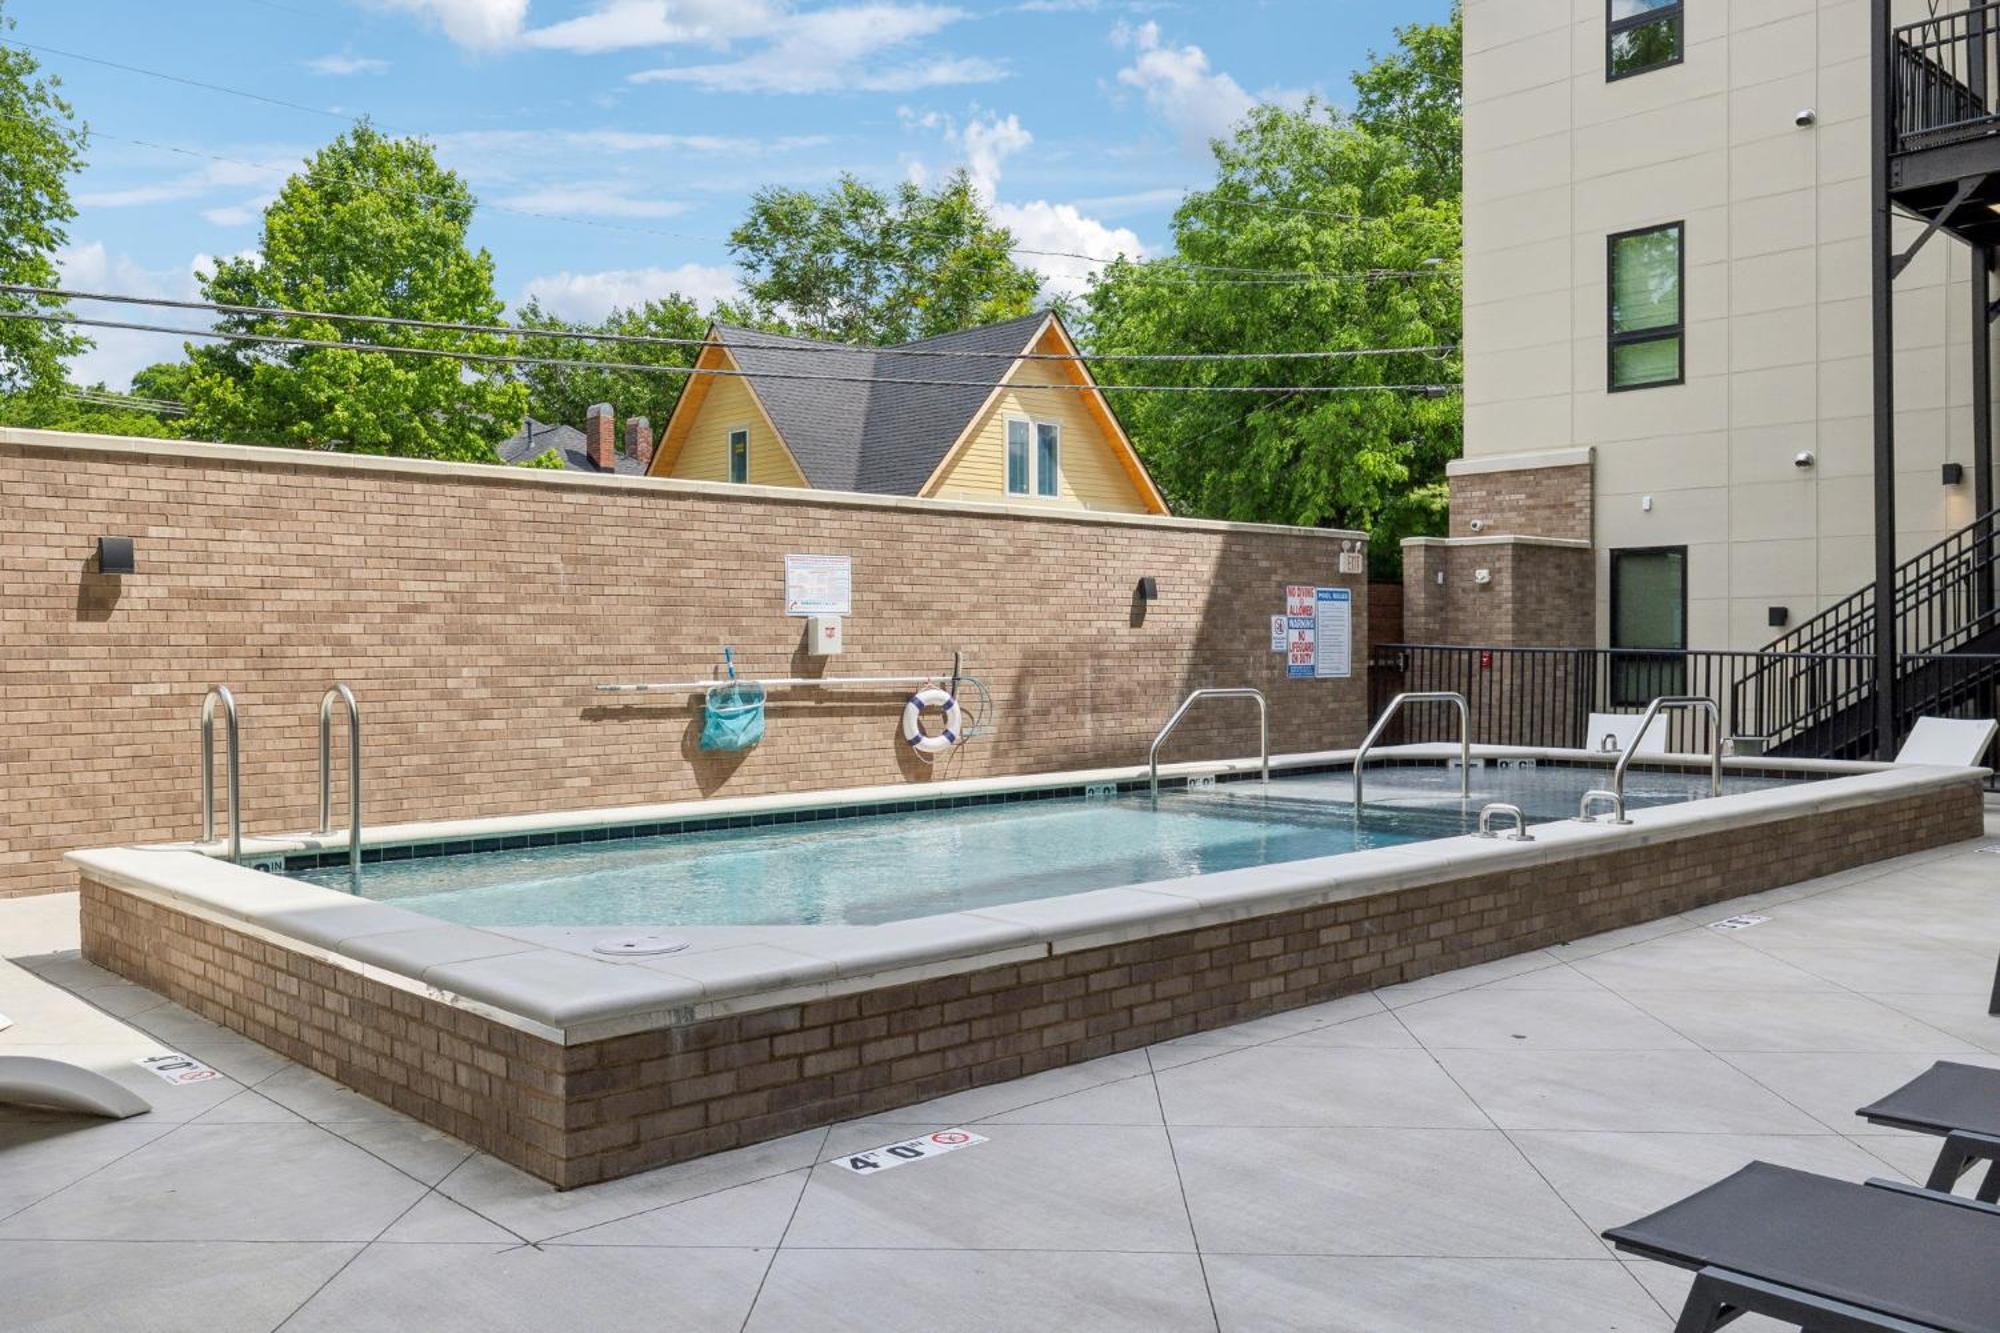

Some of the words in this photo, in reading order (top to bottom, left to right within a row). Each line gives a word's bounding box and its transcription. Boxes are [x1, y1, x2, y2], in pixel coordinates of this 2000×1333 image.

[1289, 604, 1313, 616] ALLOWED
[1298, 631, 1305, 641] NO
[1290, 642, 1314, 652] LIFEGUARD
[1299, 654, 1312, 664] DUTY
[271, 861, 282, 872] IN
[850, 1157, 881, 1170] 4
[886, 1146, 925, 1159] 0
